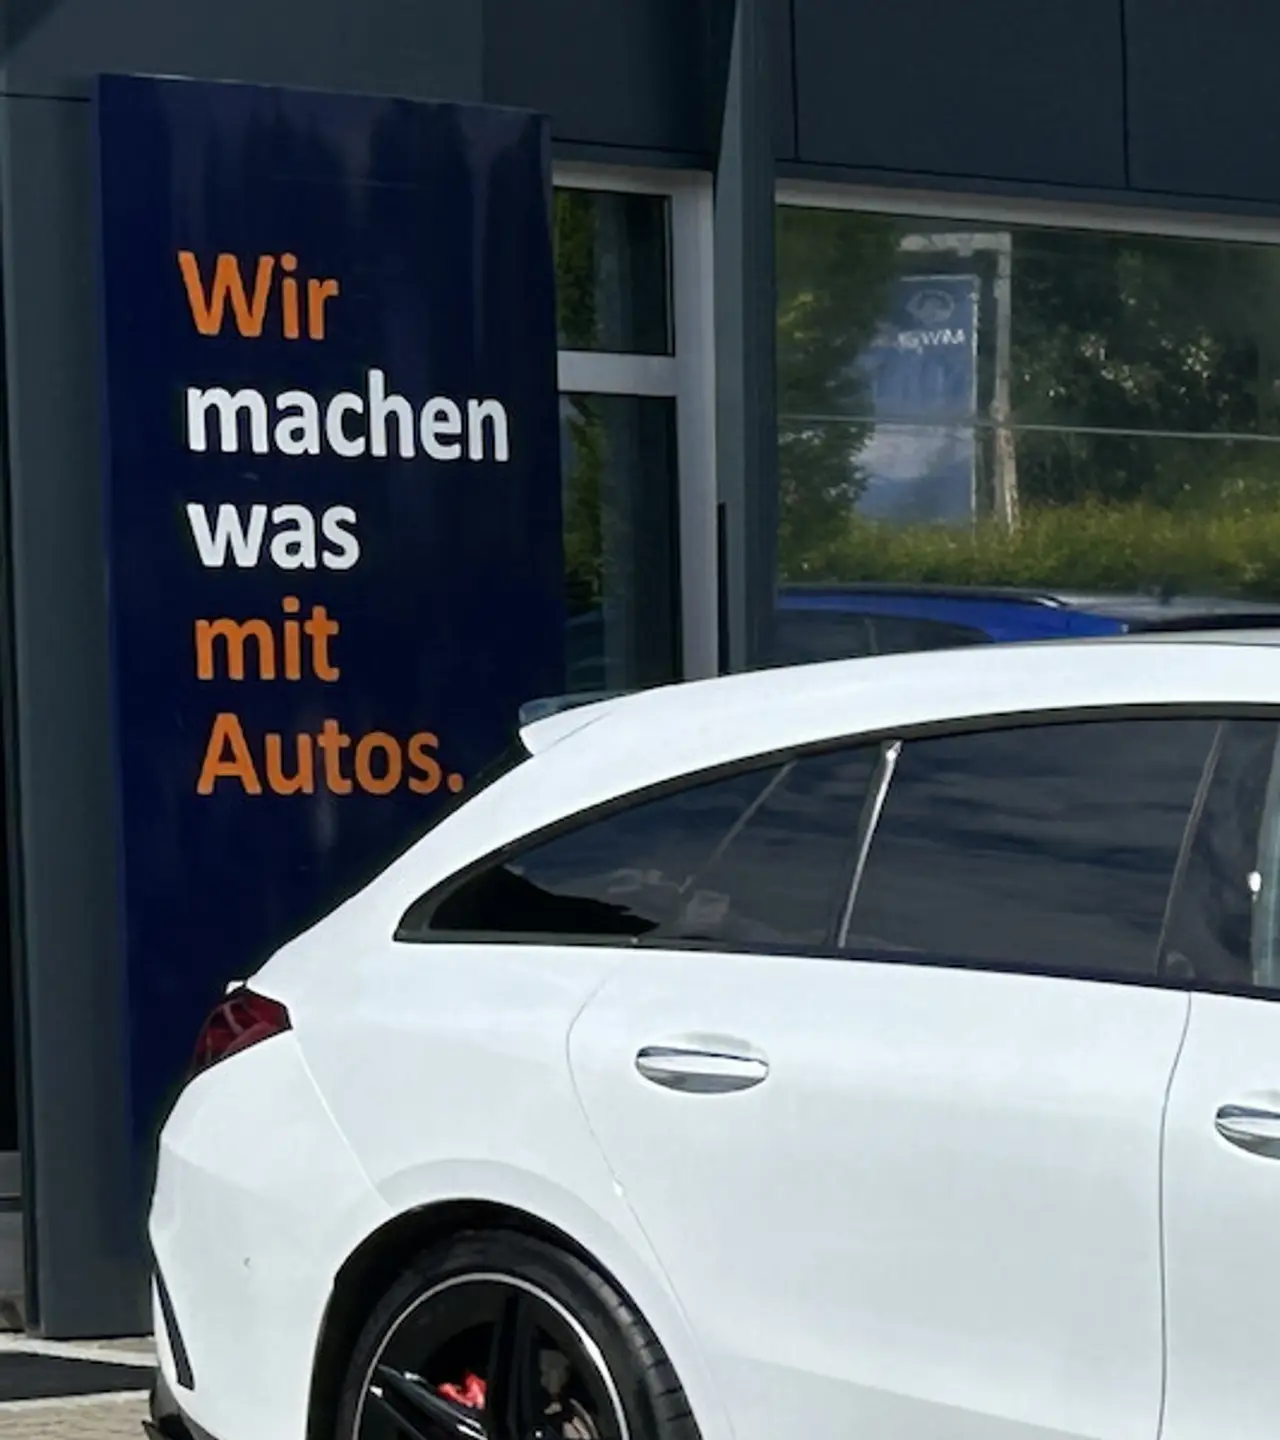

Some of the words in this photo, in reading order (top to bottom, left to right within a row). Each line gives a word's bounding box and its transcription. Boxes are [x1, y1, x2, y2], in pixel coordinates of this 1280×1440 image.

[178, 251, 340, 340] Wir
[186, 368, 510, 463] machen
[187, 502, 361, 570] was
[194, 596, 341, 682] mit
[196, 712, 464, 797] Autos.
